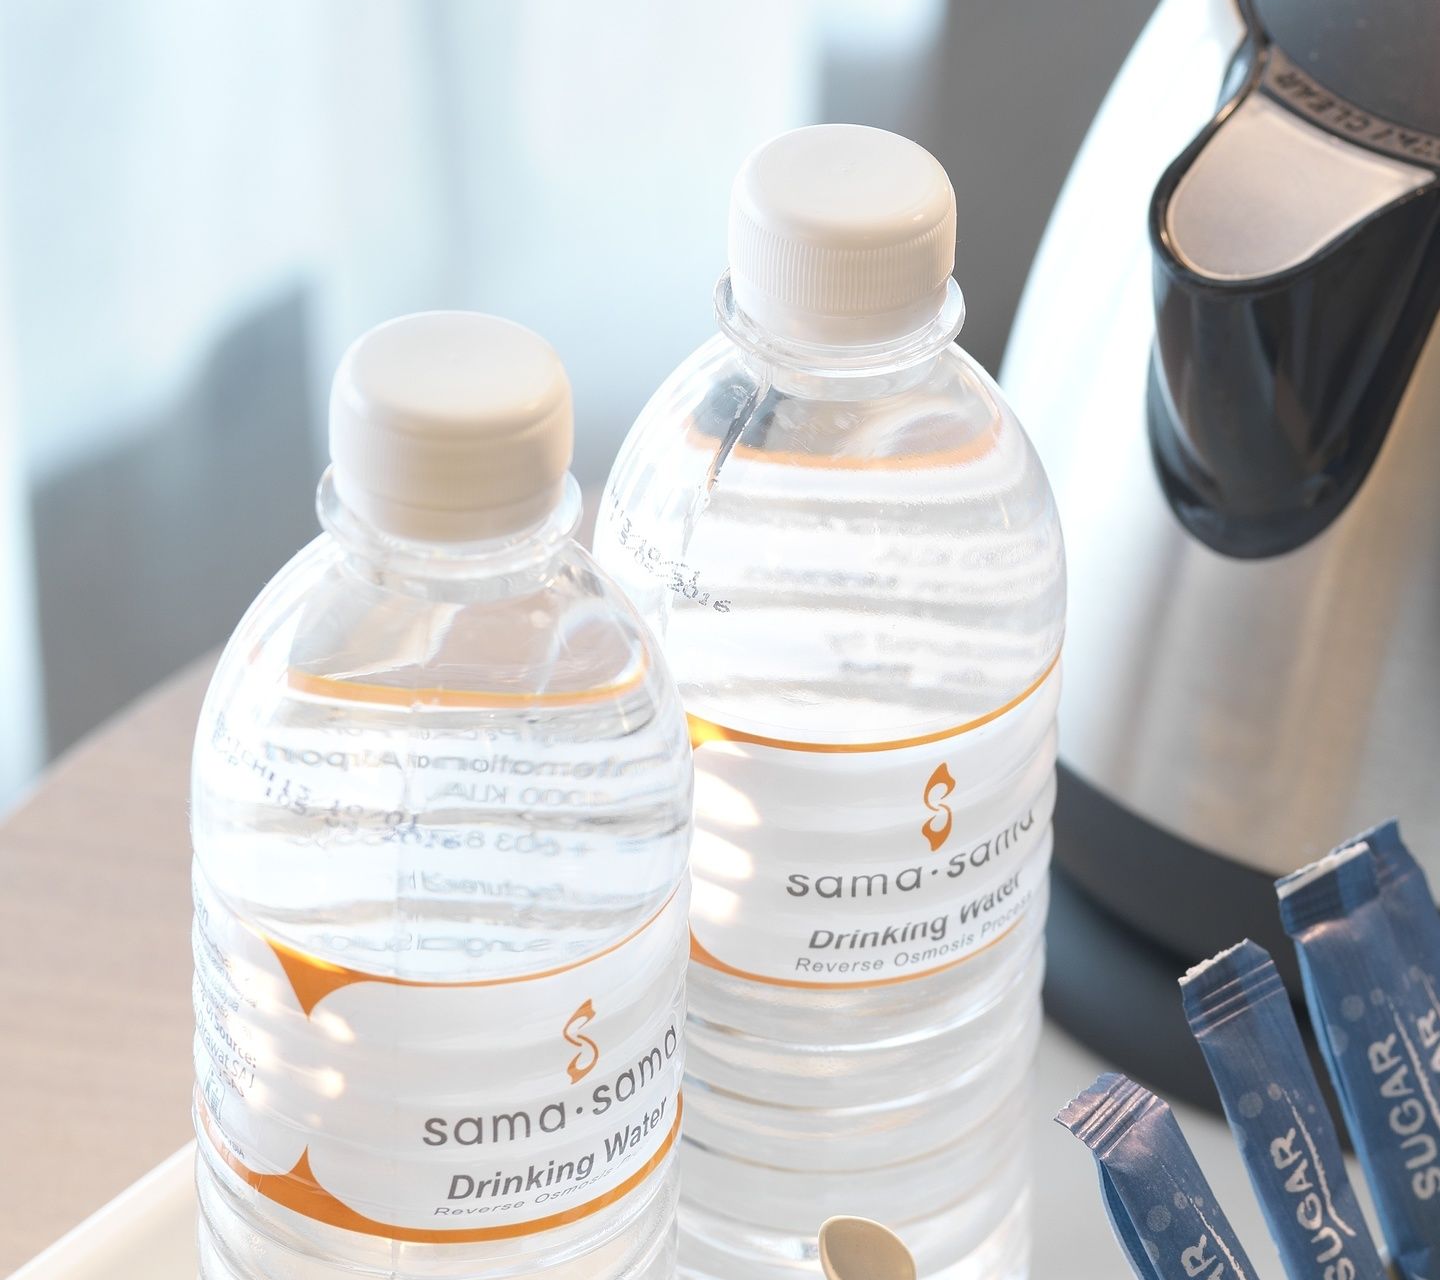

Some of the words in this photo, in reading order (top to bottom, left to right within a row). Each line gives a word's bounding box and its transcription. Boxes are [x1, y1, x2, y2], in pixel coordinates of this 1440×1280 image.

[1274, 70, 1371, 132] CLEAR
[795, 956, 885, 974] Reverse
[893, 930, 975, 968] Osmosis
[980, 889, 1033, 938] Process
[808, 913, 949, 951] Drinking
[959, 866, 1023, 925] Water
[447, 1151, 596, 1201] Drinking
[604, 1095, 668, 1164] Water
[434, 1199, 526, 1217] Reverse
[534, 1168, 615, 1204] Osmosis
